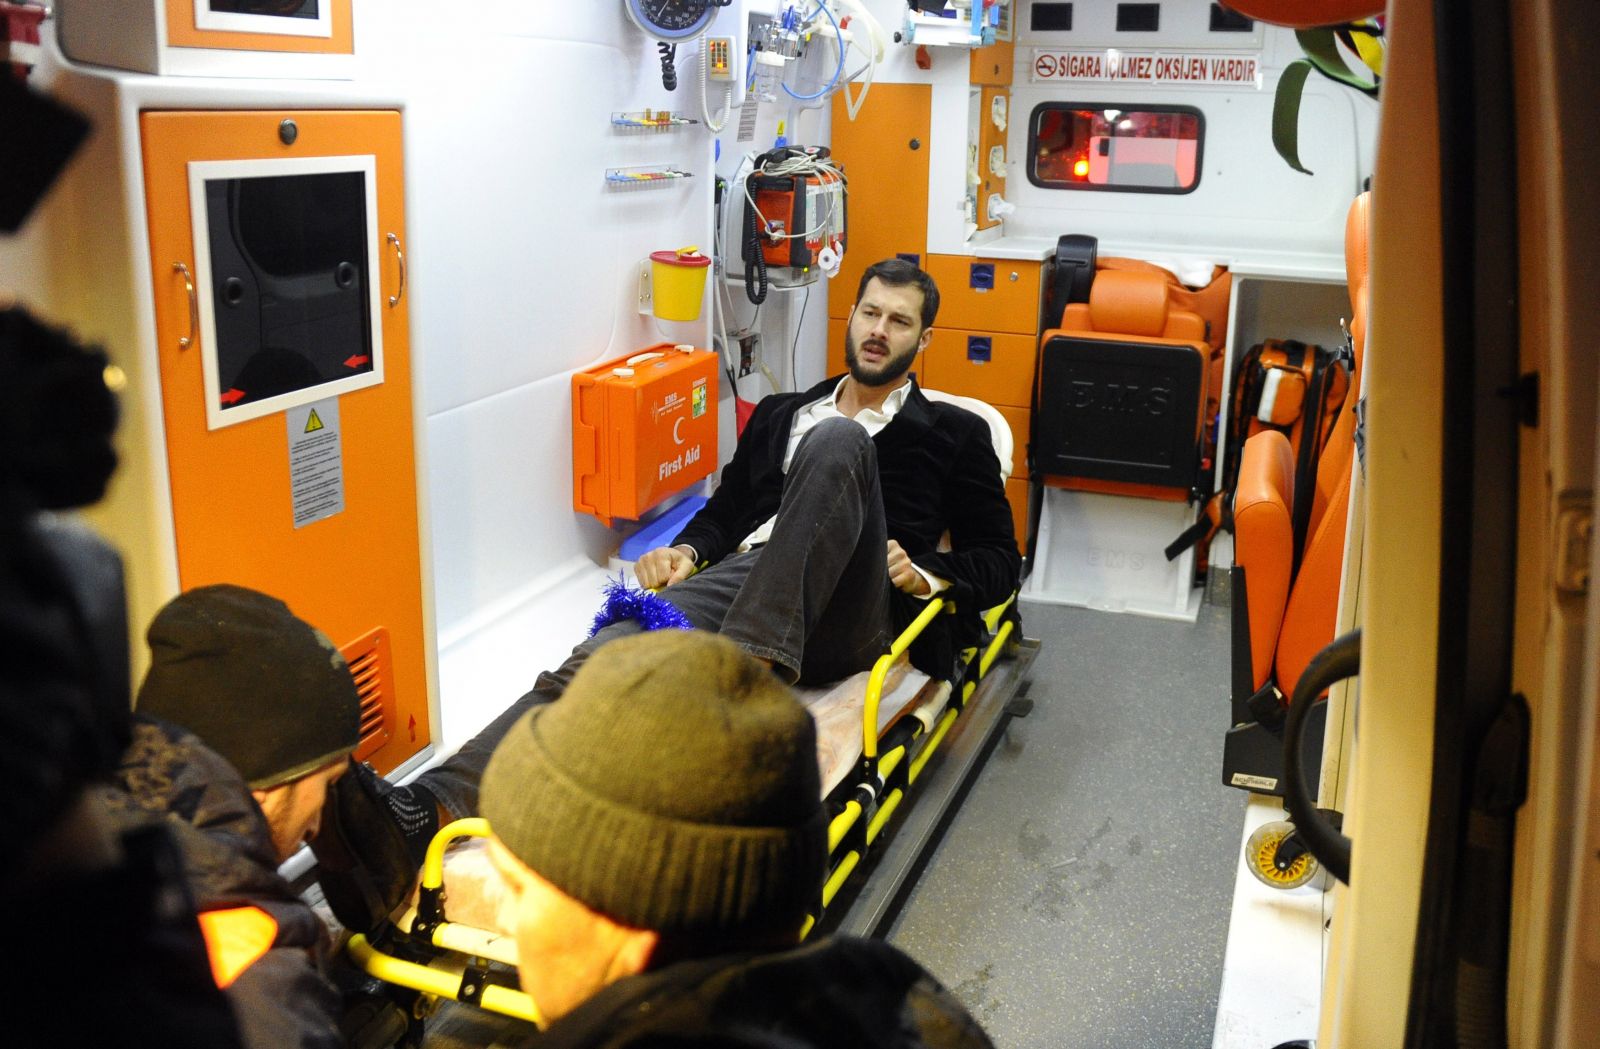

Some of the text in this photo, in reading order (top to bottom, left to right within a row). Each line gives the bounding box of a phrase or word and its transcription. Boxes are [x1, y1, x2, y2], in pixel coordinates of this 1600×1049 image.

[1058, 53, 1101, 77] SİGARA
[1155, 55, 1208, 81] OKSİJEN
[1211, 58, 1256, 82] VARDIR
[664, 392, 678, 405] EMS
[659, 444, 700, 481] First Aid
[1087, 546, 1145, 571] EMS
